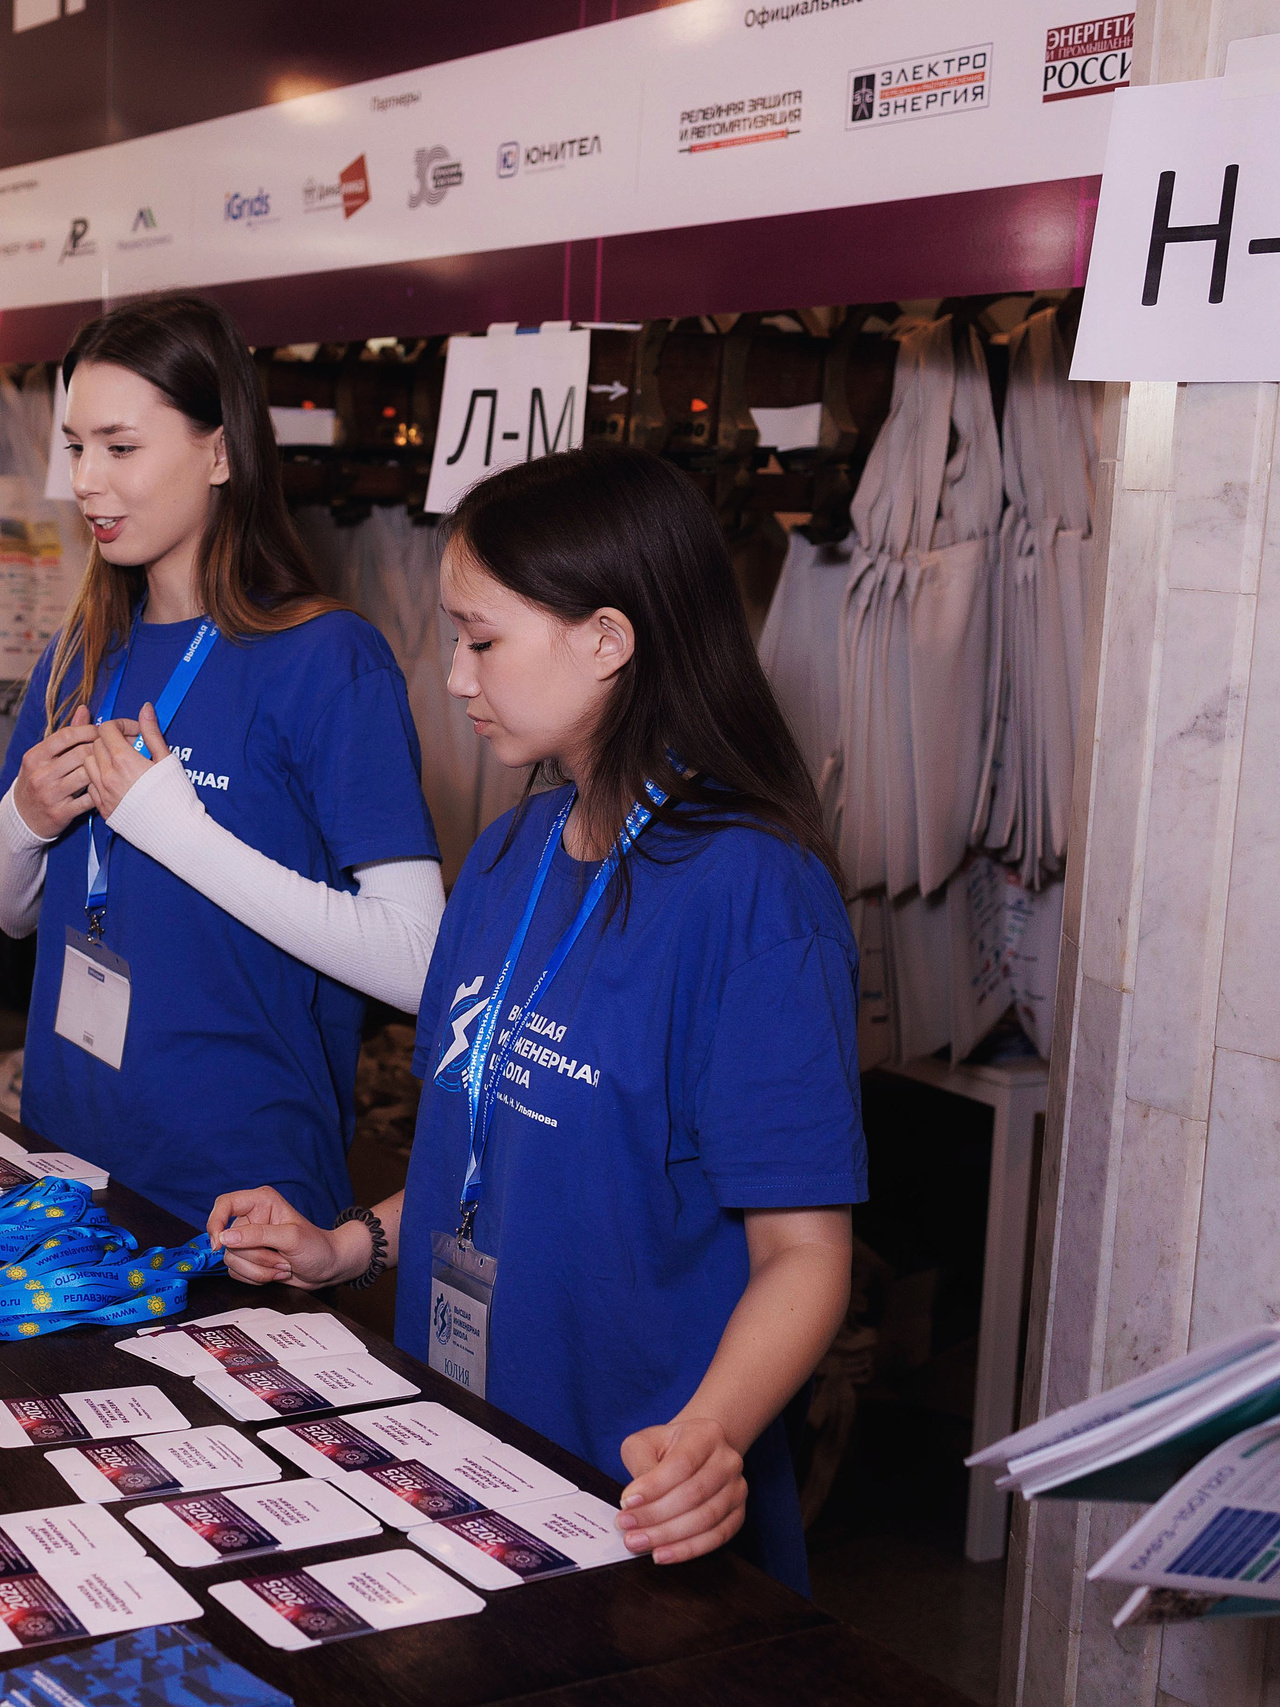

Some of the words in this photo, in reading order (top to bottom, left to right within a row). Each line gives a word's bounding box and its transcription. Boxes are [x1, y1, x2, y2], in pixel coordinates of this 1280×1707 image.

[880, 52, 987, 86] ЭЛЕКТРО
[748, 90, 802, 113] ЗАЩИТА
[879, 84, 985, 117] ЭНЕРГИЯ
[524, 135, 602, 168] ЮНИТЕЛ
[224, 187, 271, 220] iGrids
[446, 386, 576, 466] Л-М
[183, 625, 208, 662] ВЫСШАЯ
[524, 970, 548, 1009] ШКОЛА
[469, 1005, 492, 1082] ИНЖЕНЕРНАЯ
[491, 961, 510, 1000] ШКОЛА
[485, 1000, 502, 1040] Ульянова
[507, 1005, 568, 1043] ВШАЯ
[497, 1028, 601, 1088] ИЖЕНЕРНАЯ
[515, 1100, 558, 1128] Ульянова
[55, 1271, 119, 1286] РЕЛАВЭКСПО
[198, 1331, 233, 1348] 2025
[244, 1371, 280, 1390] 2025
[312, 1373, 338, 1389] ПЕТРОВА
[319, 1370, 349, 1389] КРИСТИНА
[444, 1358, 470, 1387] ЮЛИЯ
[19, 1401, 46, 1419] 2025
[301, 1425, 343, 1445] 2025
[382, 1415, 434, 1446] ВЛАДИМИРОВИЧ
[384, 1424, 412, 1439] СЕРГЕЙ
[94, 1447, 129, 1468] 2025
[378, 1468, 425, 1491] 2025
[460, 1457, 520, 1493] АЛЕКСАНДРОВИЧ
[460, 1464, 501, 1488] ВЛАДИМИР
[180, 1501, 221, 1525] 2025
[264, 1498, 302, 1524] АЛЕКСАНДР
[275, 1497, 311, 1521] СЕРГЕЕВИЧ
[459, 1520, 506, 1545] 2025
[548, 1519, 580, 1536] СЕРГЕЙ
[551, 1513, 597, 1539] АНДРЕЕВИЧ
[259, 1579, 308, 1607] 2025
